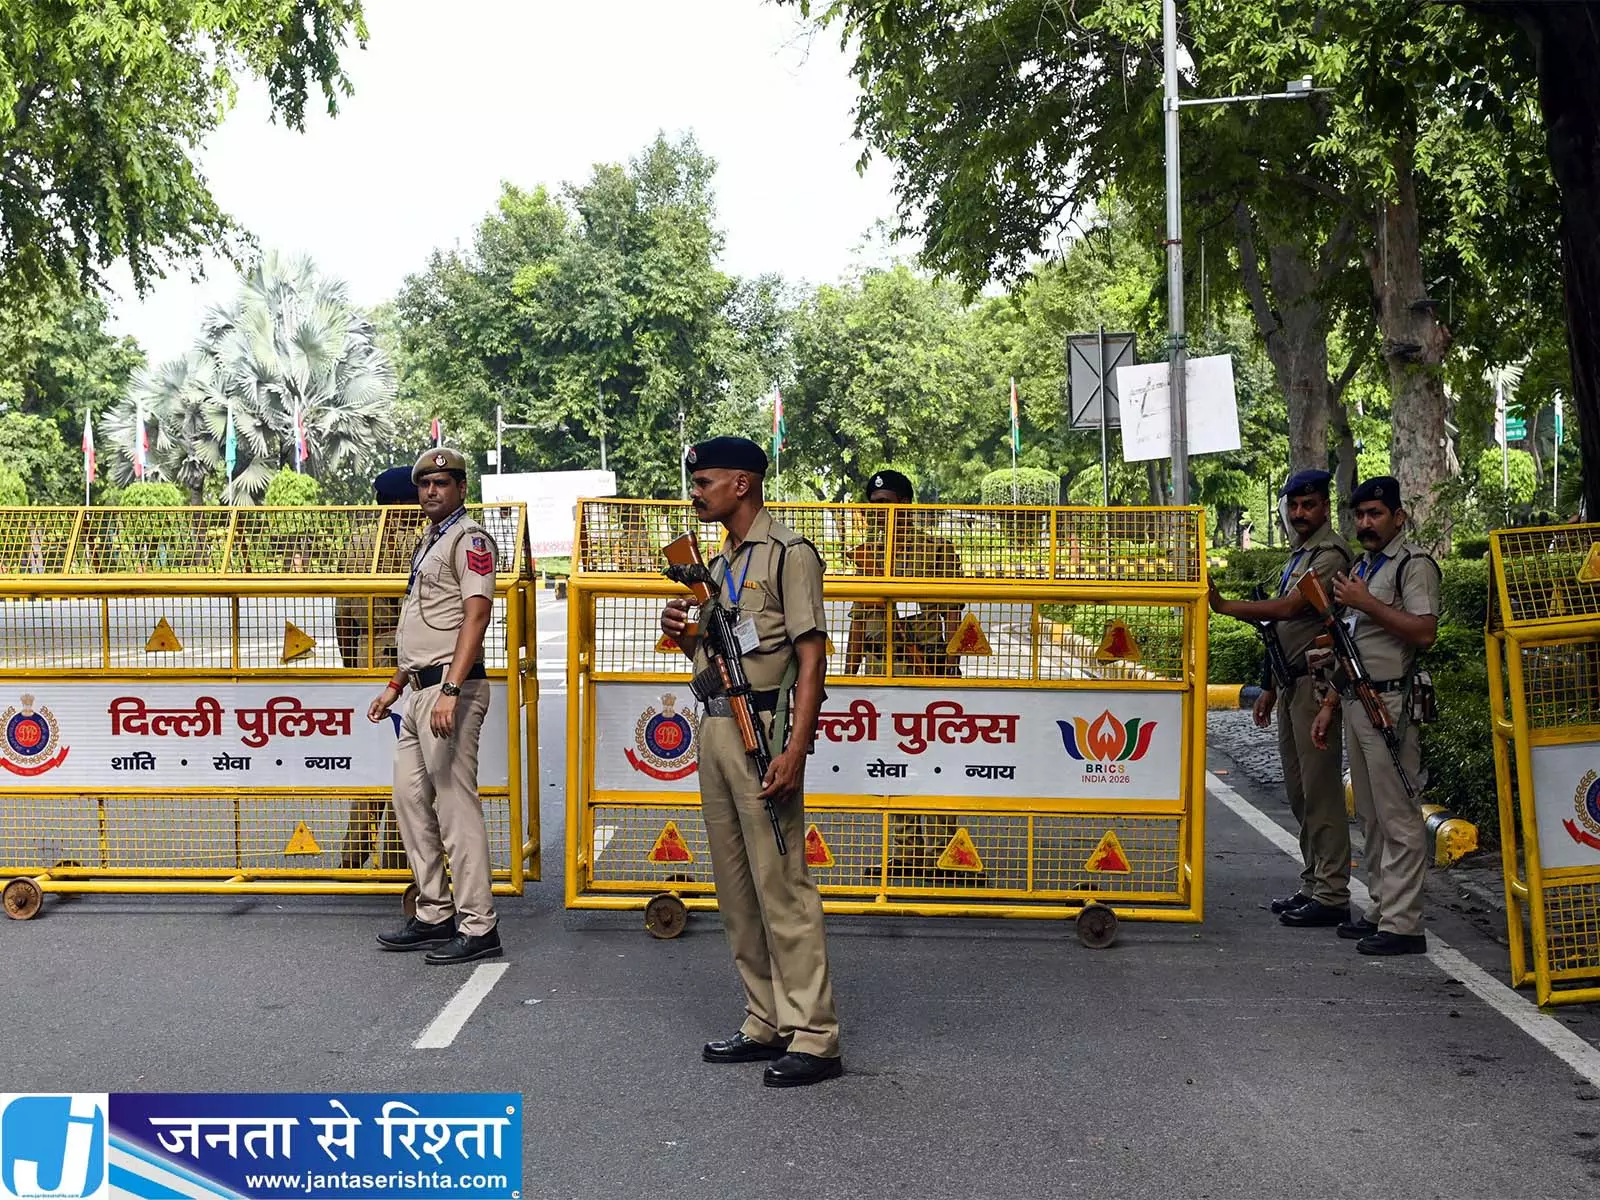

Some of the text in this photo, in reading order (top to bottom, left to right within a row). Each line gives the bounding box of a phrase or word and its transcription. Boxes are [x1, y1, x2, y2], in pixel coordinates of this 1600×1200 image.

[108, 696, 354, 748] दिल्ली पुलिस
[892, 700, 1020, 755] पुलिस
[111, 751, 352, 771] शांति सेवा न्याय
[866, 758, 1017, 780] सेवा न्याय
[1085, 763, 1126, 774] BRICS
[1081, 775, 1130, 784] INDIA 2026
